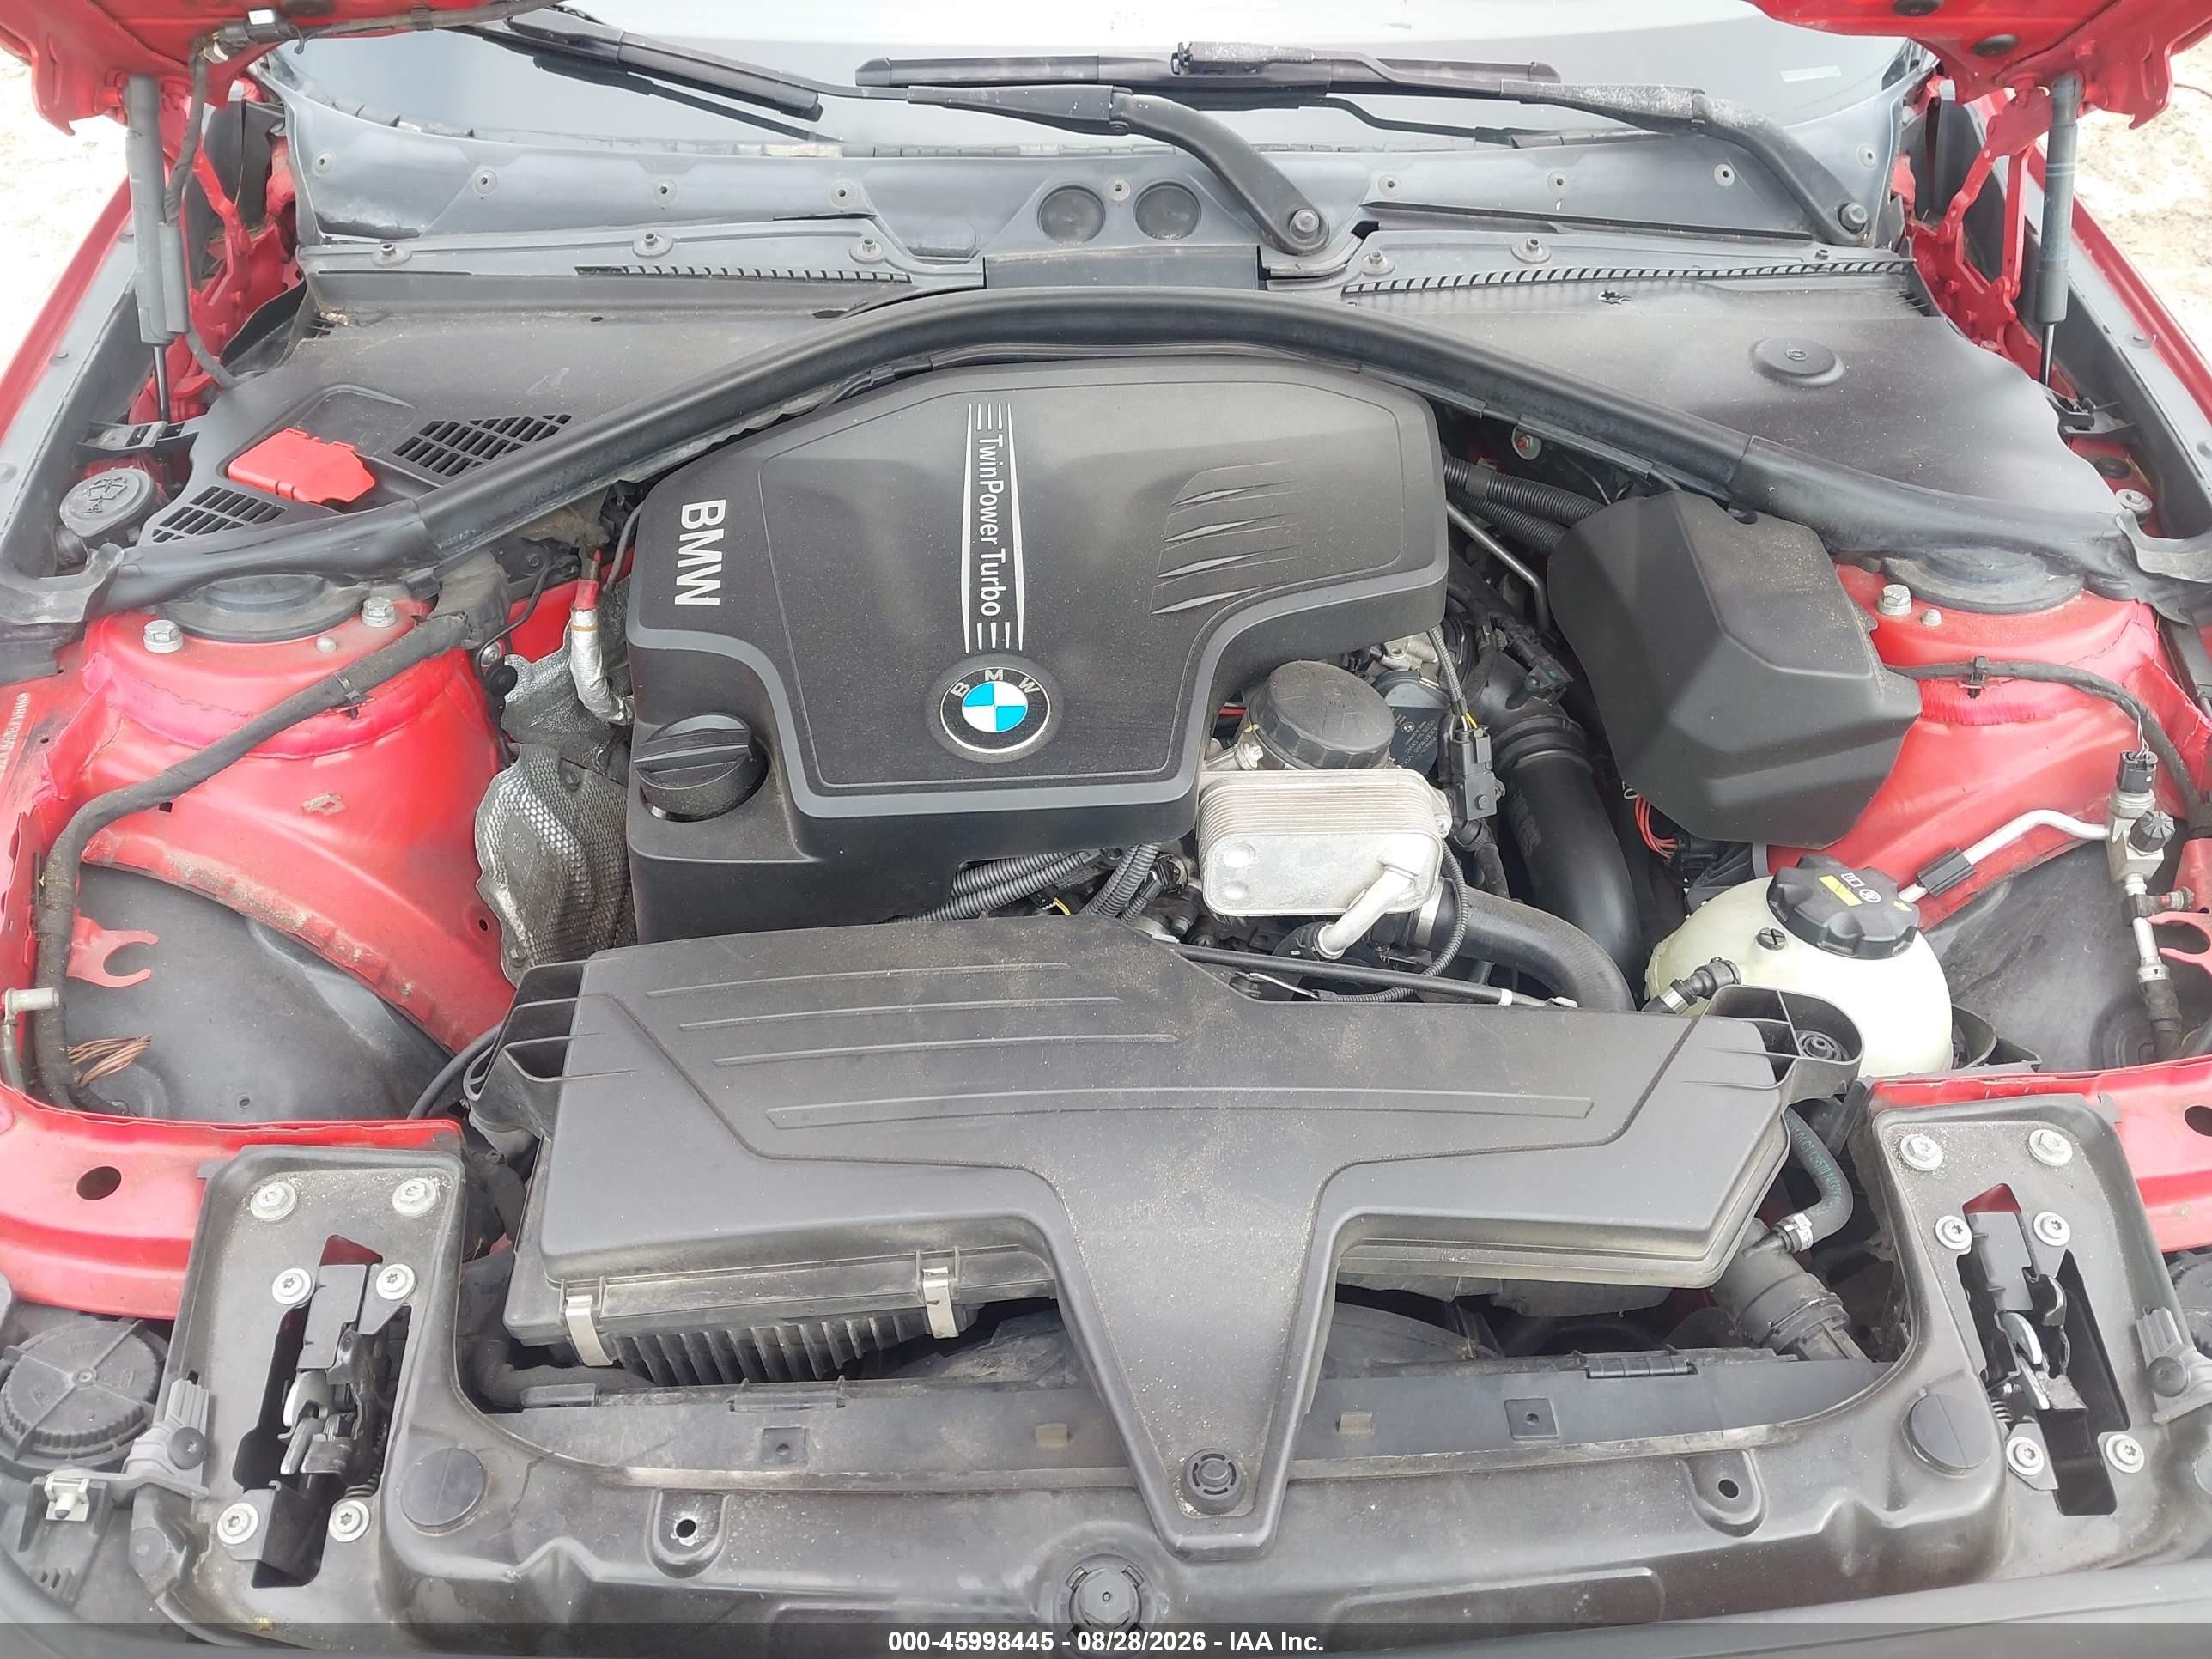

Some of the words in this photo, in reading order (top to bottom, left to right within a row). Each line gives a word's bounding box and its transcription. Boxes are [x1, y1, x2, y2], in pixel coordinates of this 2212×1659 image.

[978, 434, 1005, 545] TwinPower
[674, 499, 726, 605] BMW
[980, 548, 1007, 617] Turbo
[950, 669, 1041, 698] BMW
